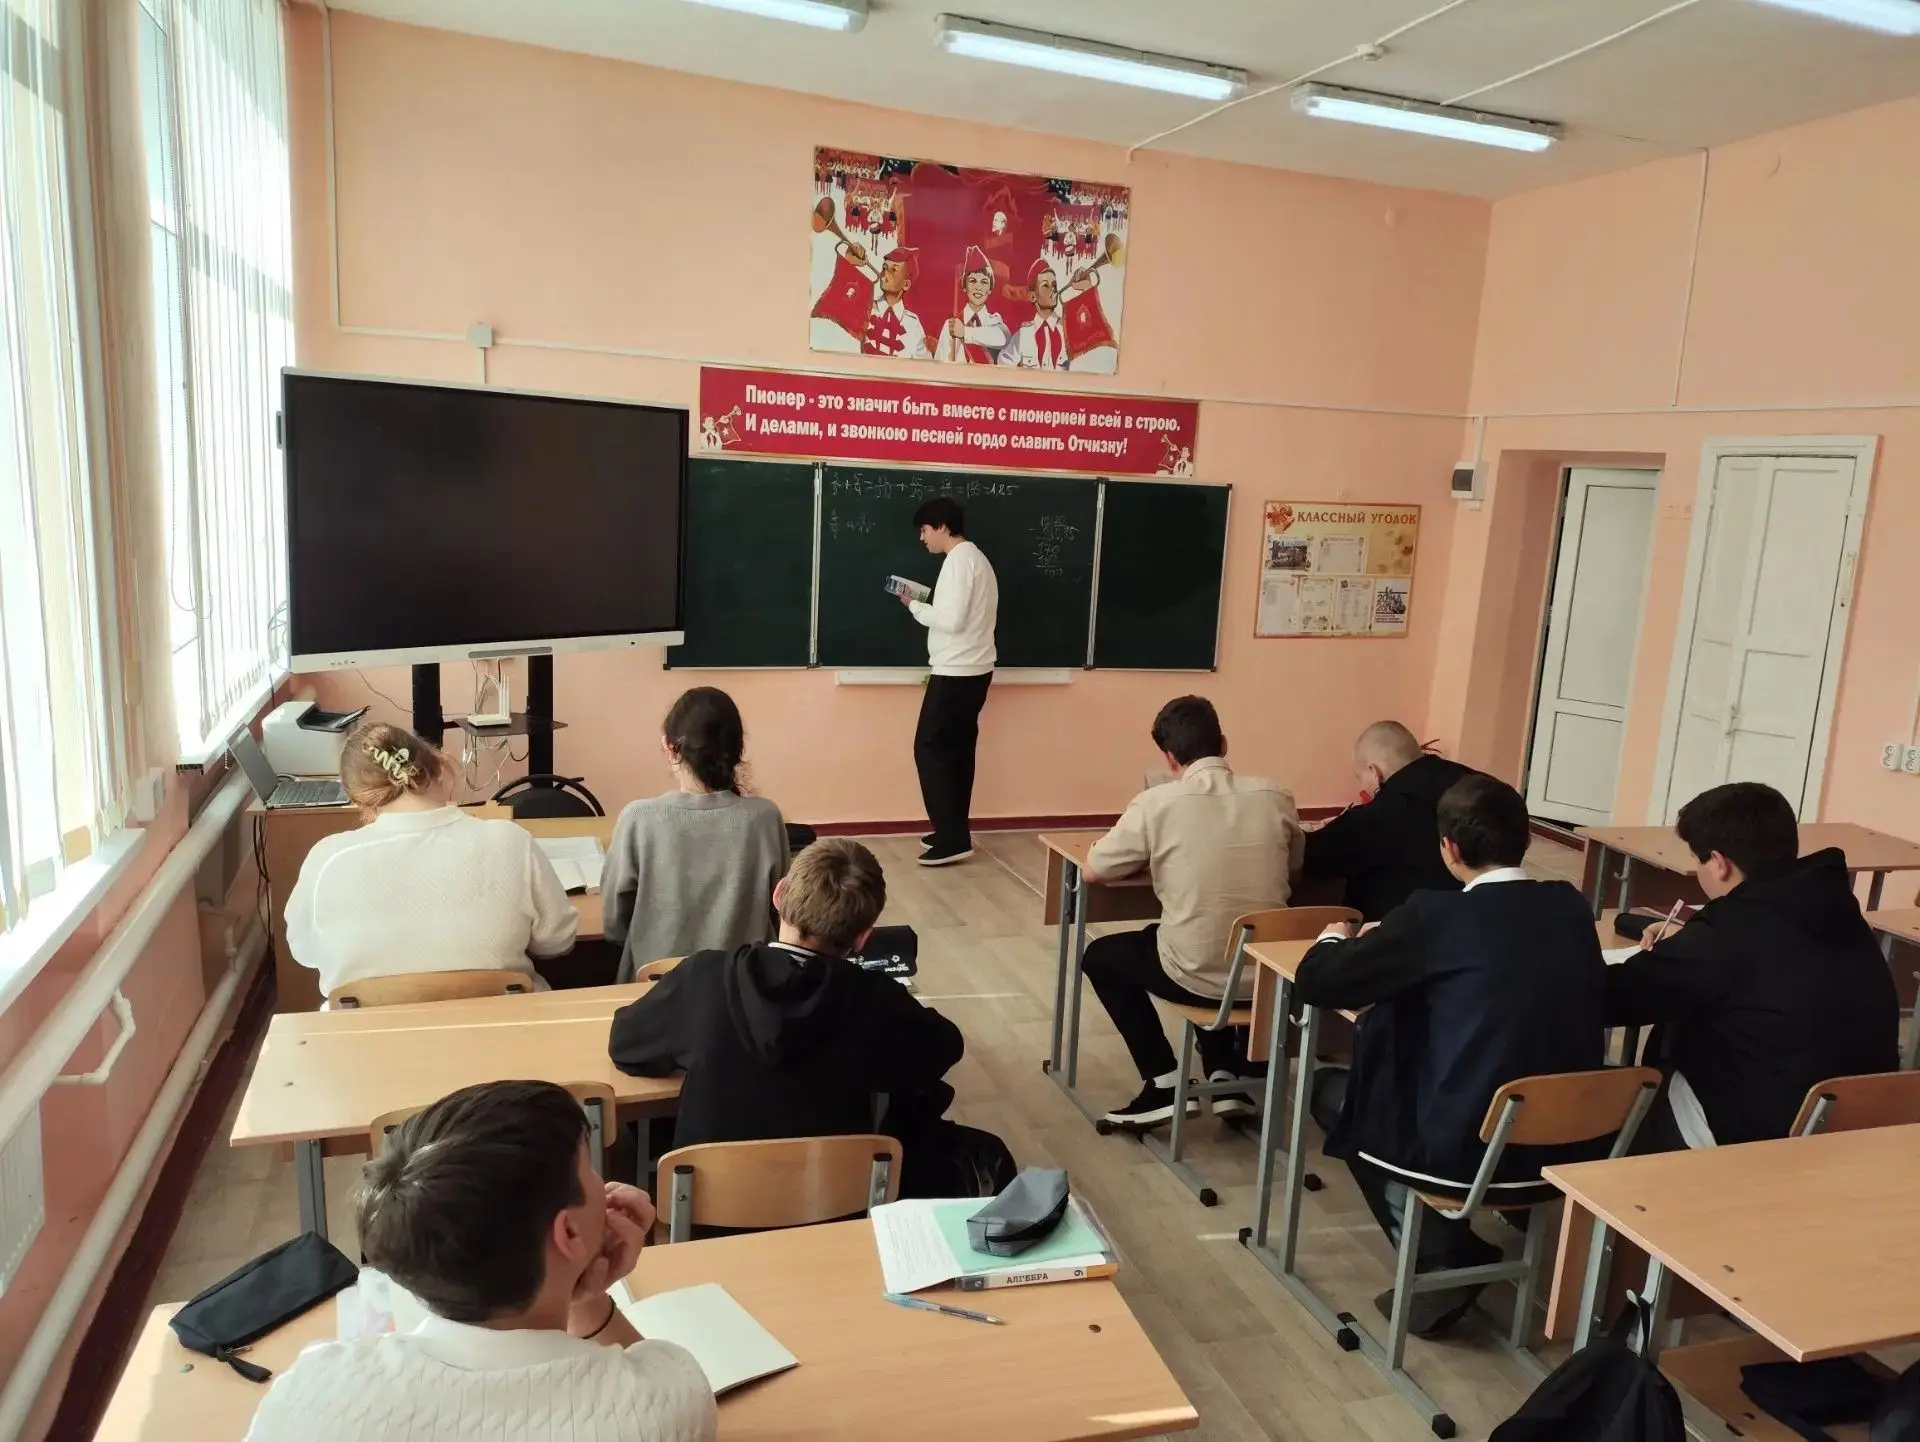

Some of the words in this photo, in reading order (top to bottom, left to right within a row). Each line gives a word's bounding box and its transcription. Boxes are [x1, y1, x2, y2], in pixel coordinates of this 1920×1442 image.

[745, 384, 806, 411] Пионер
[817, 394, 844, 410] это
[846, 396, 900, 414] значит
[902, 395, 939, 416] быть
[942, 403, 995, 421] вместе
[998, 407, 1007, 421] с
[1009, 407, 1086, 428] пионерией
[1089, 410, 1122, 428] всей
[1124, 415, 1133, 429] в
[1135, 416, 1181, 433] строю.
[745, 412, 757, 432] И
[759, 418, 824, 440] делами,
[827, 423, 837, 437] и
[840, 423, 909, 442] звонкою
[911, 426, 964, 445] песней
[967, 432, 1008, 450] гордо
[1010, 434, 1065, 451] славить
[1067, 434, 1128, 458] Отчизну!
[1297, 511, 1366, 523] КЛАССНЫЙ
[1371, 513, 1417, 525] УГОЛОК
[1006, 1272, 1049, 1285] АЛГЕБРА
